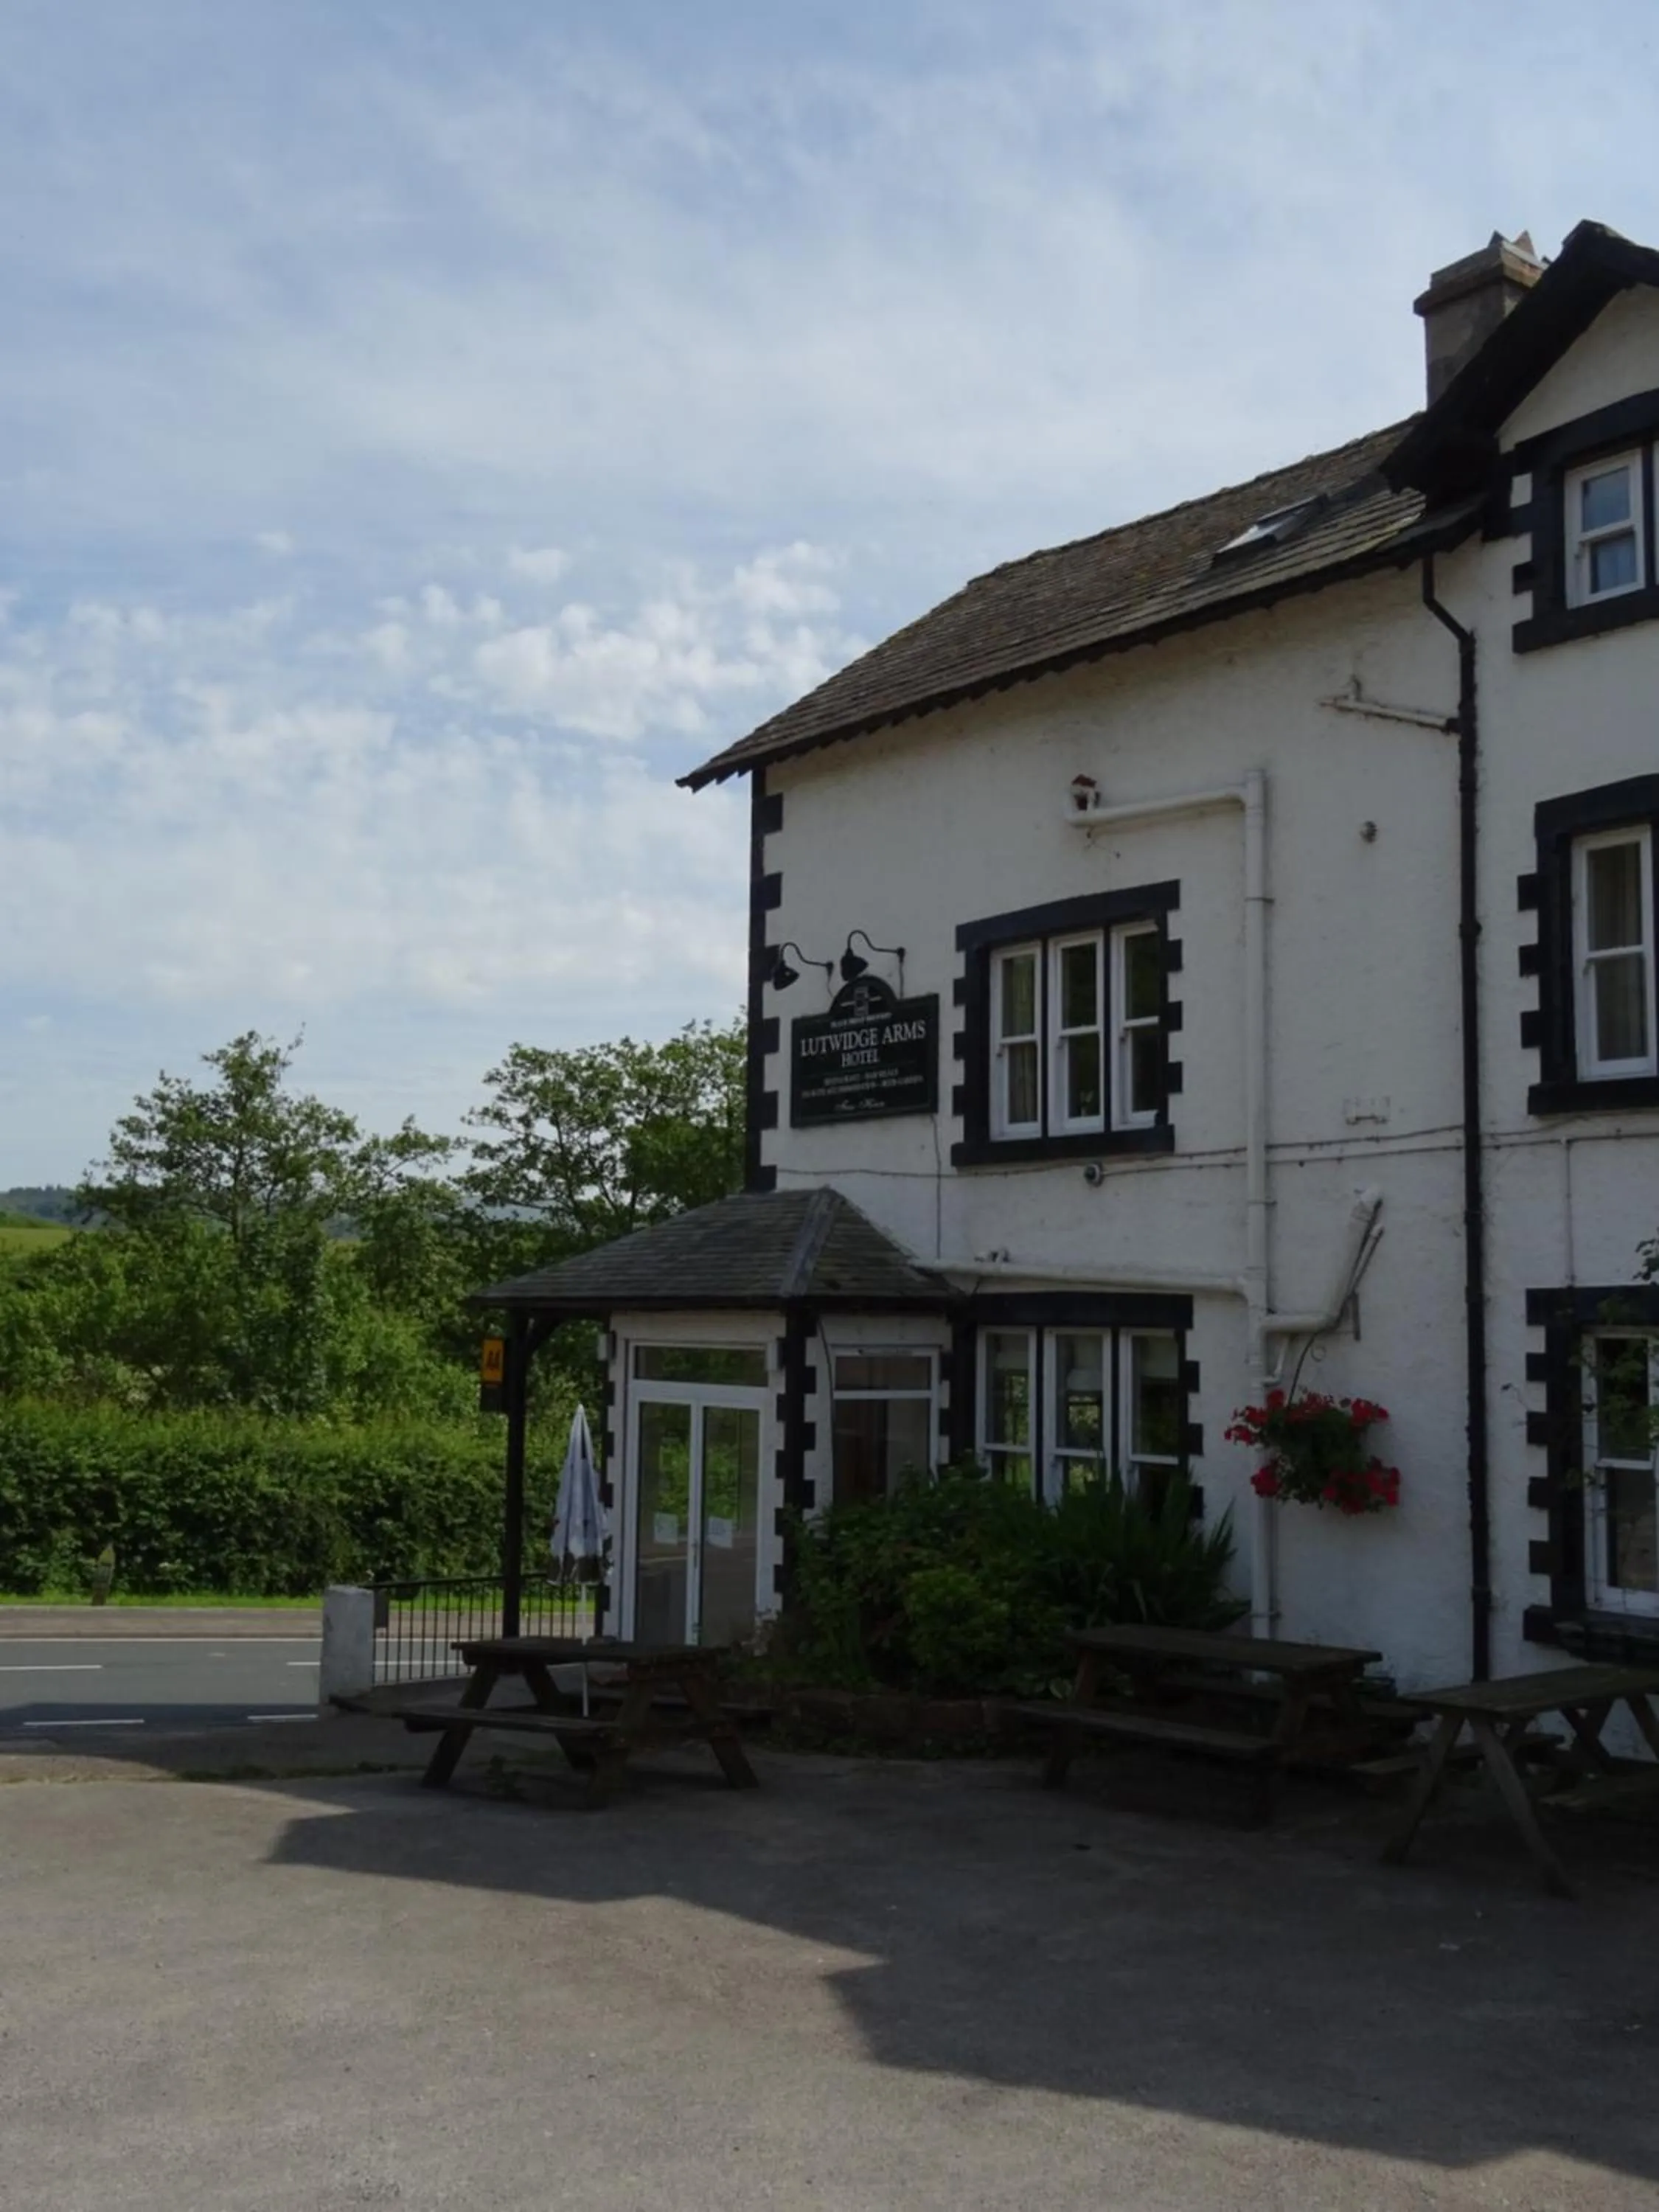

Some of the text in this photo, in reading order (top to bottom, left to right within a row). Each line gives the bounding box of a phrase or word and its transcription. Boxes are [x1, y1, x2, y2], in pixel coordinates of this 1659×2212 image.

[801, 1028, 879, 1057] LUTWIDGE
[882, 1020, 926, 1044] ARMS
[841, 1048, 880, 1068] HOTEL
